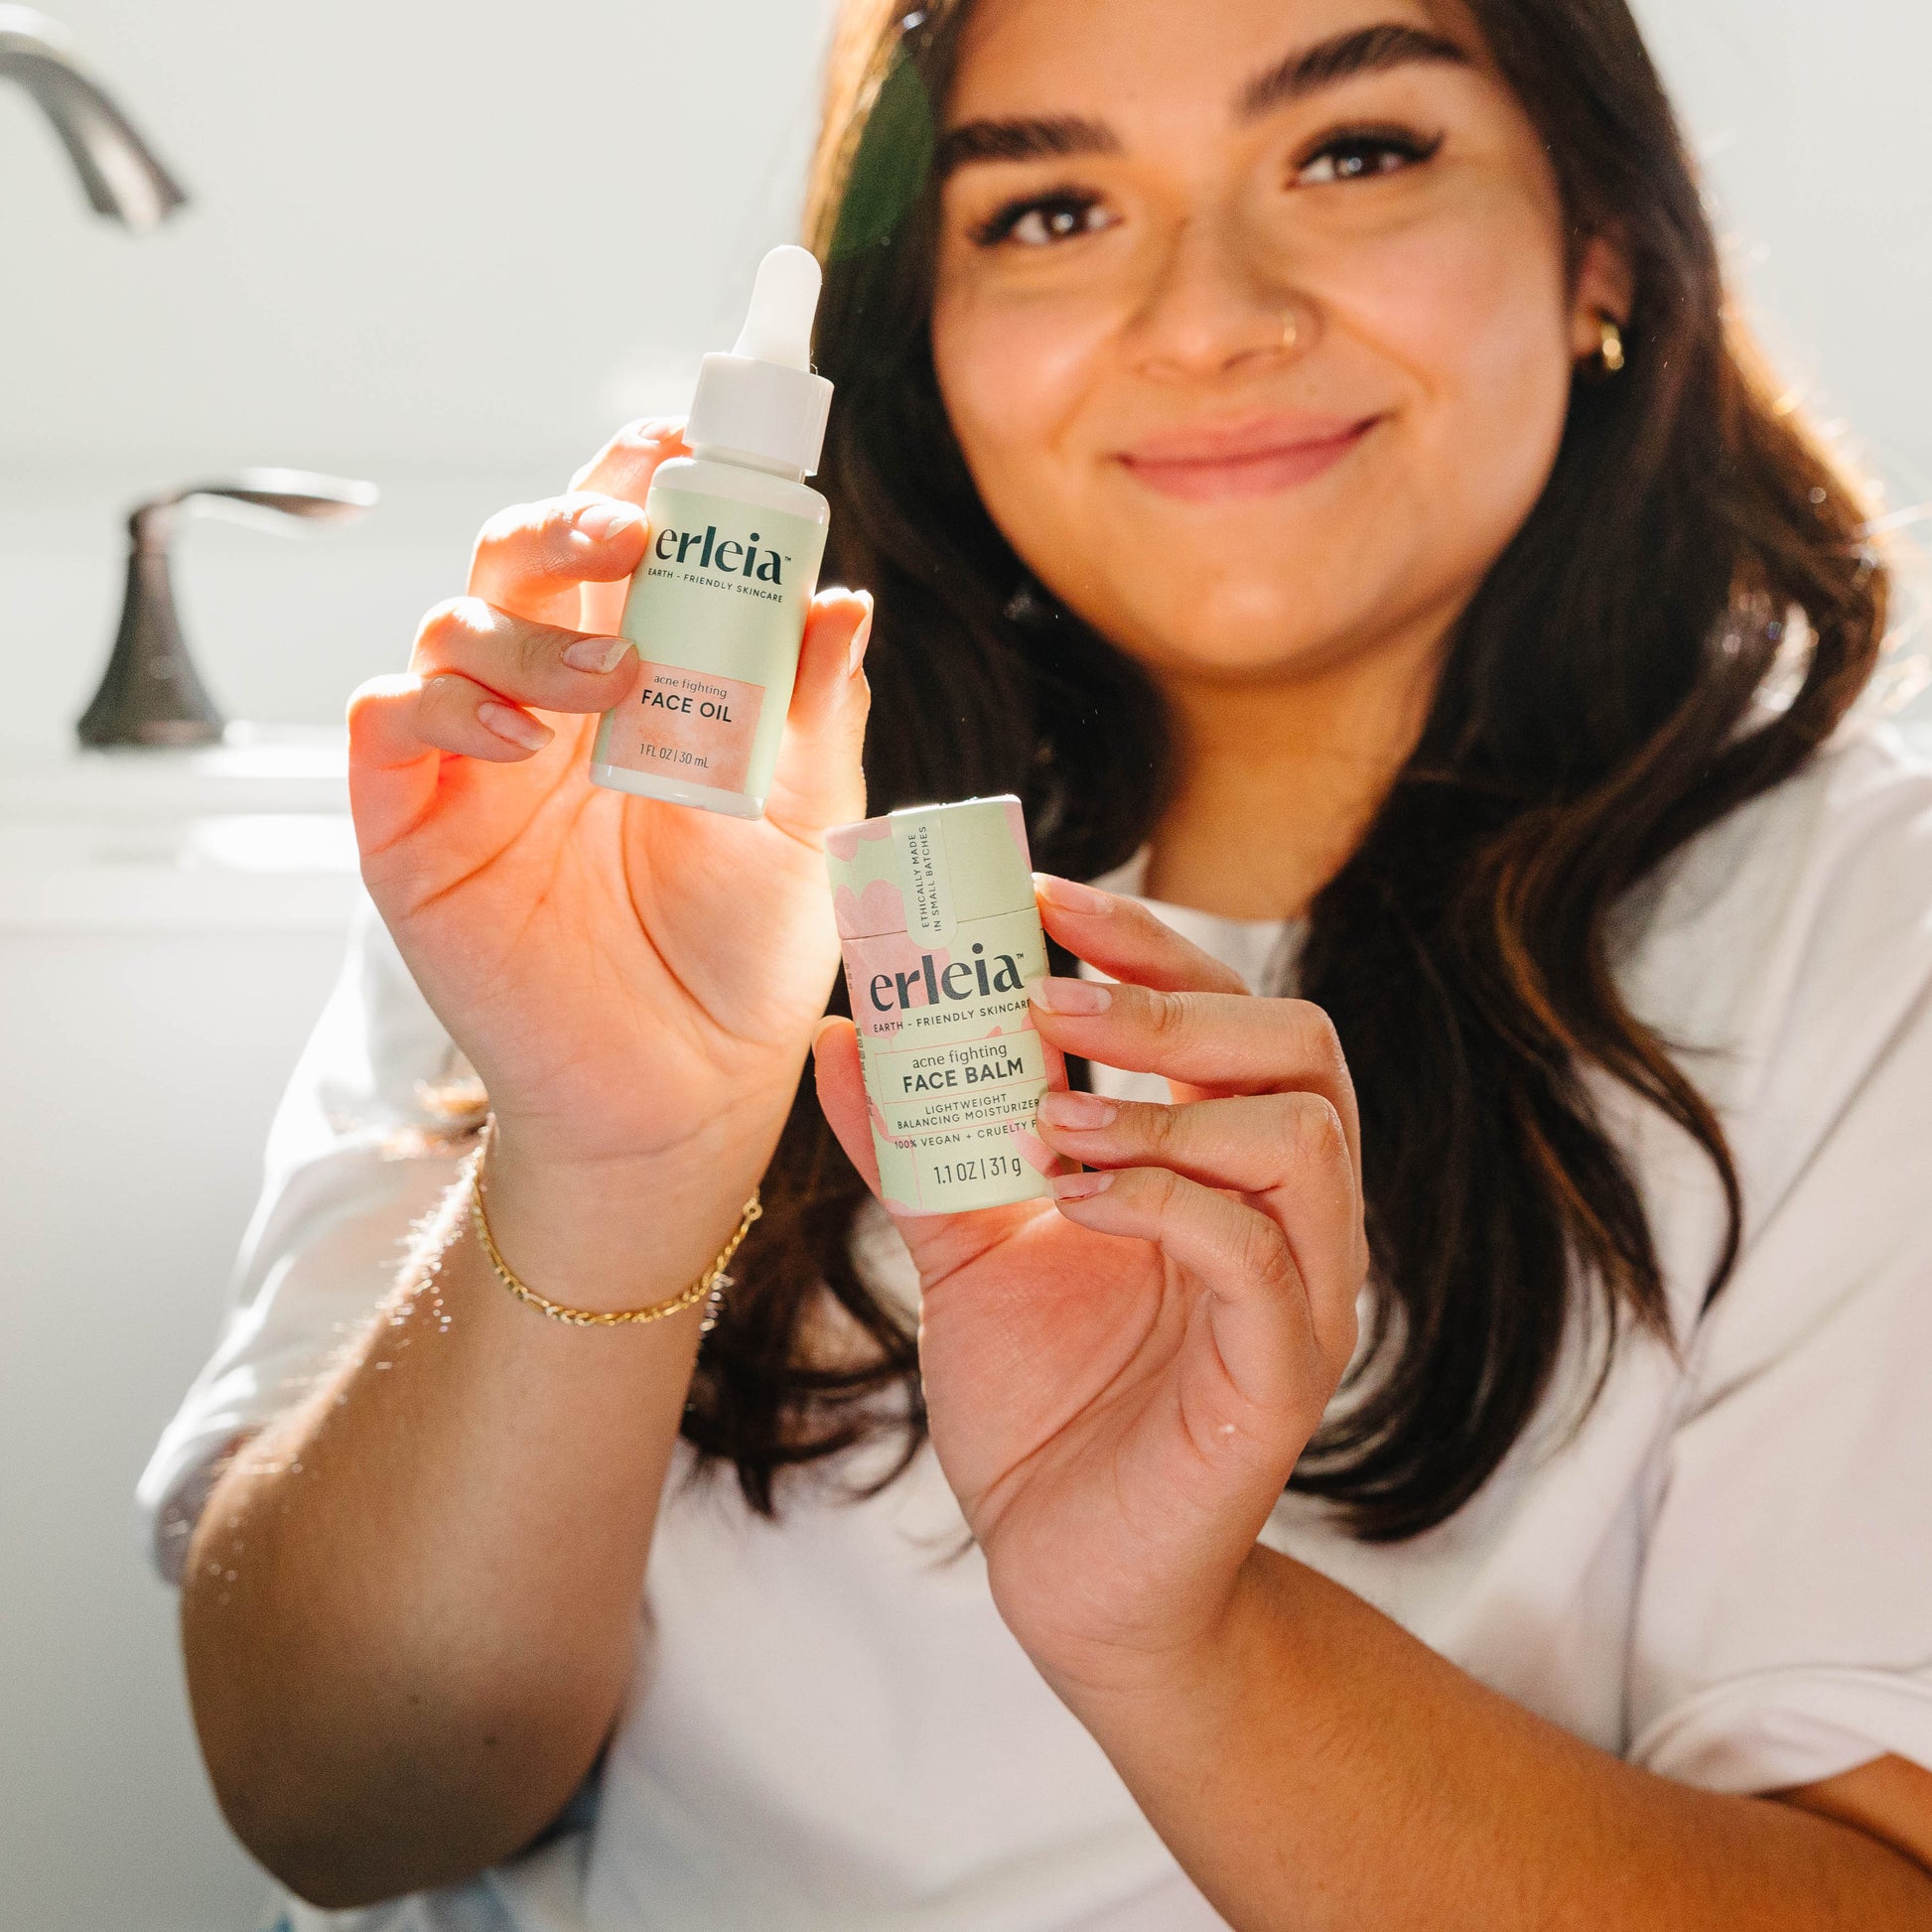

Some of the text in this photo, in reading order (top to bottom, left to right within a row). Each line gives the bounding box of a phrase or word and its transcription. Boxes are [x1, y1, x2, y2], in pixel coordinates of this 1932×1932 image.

[647, 568, 673, 579] EARTH
[683, 574, 733, 590] FRIENDLY
[737, 585, 783, 604] SKINCARE
[653, 675, 728, 699] acne fighting
[641, 689, 733, 723] FACE OIL
[645, 745, 657, 757] FL
[694, 757, 709, 768] mL
[908, 834, 929, 927] ETHICALLY MADE
[919, 826, 941, 932] IN SMALL BATCHES
[874, 1021, 903, 1034] EARTH
[916, 1010, 975, 1028] FRIENDLY
[912, 1044, 1008, 1069] acne fighting
[902, 1057, 1024, 1093] FACE BALM
[897, 1098, 1039, 1130] BALANCING MOISTURIZER
[925, 1093, 1007, 1115] LIGHTWEIGHT
[895, 1139, 917, 1150] 100%
[920, 1134, 961, 1147] VEGAN
[977, 1122, 1028, 1139] CRUELTY
[933, 1165, 952, 1184] 1.1
